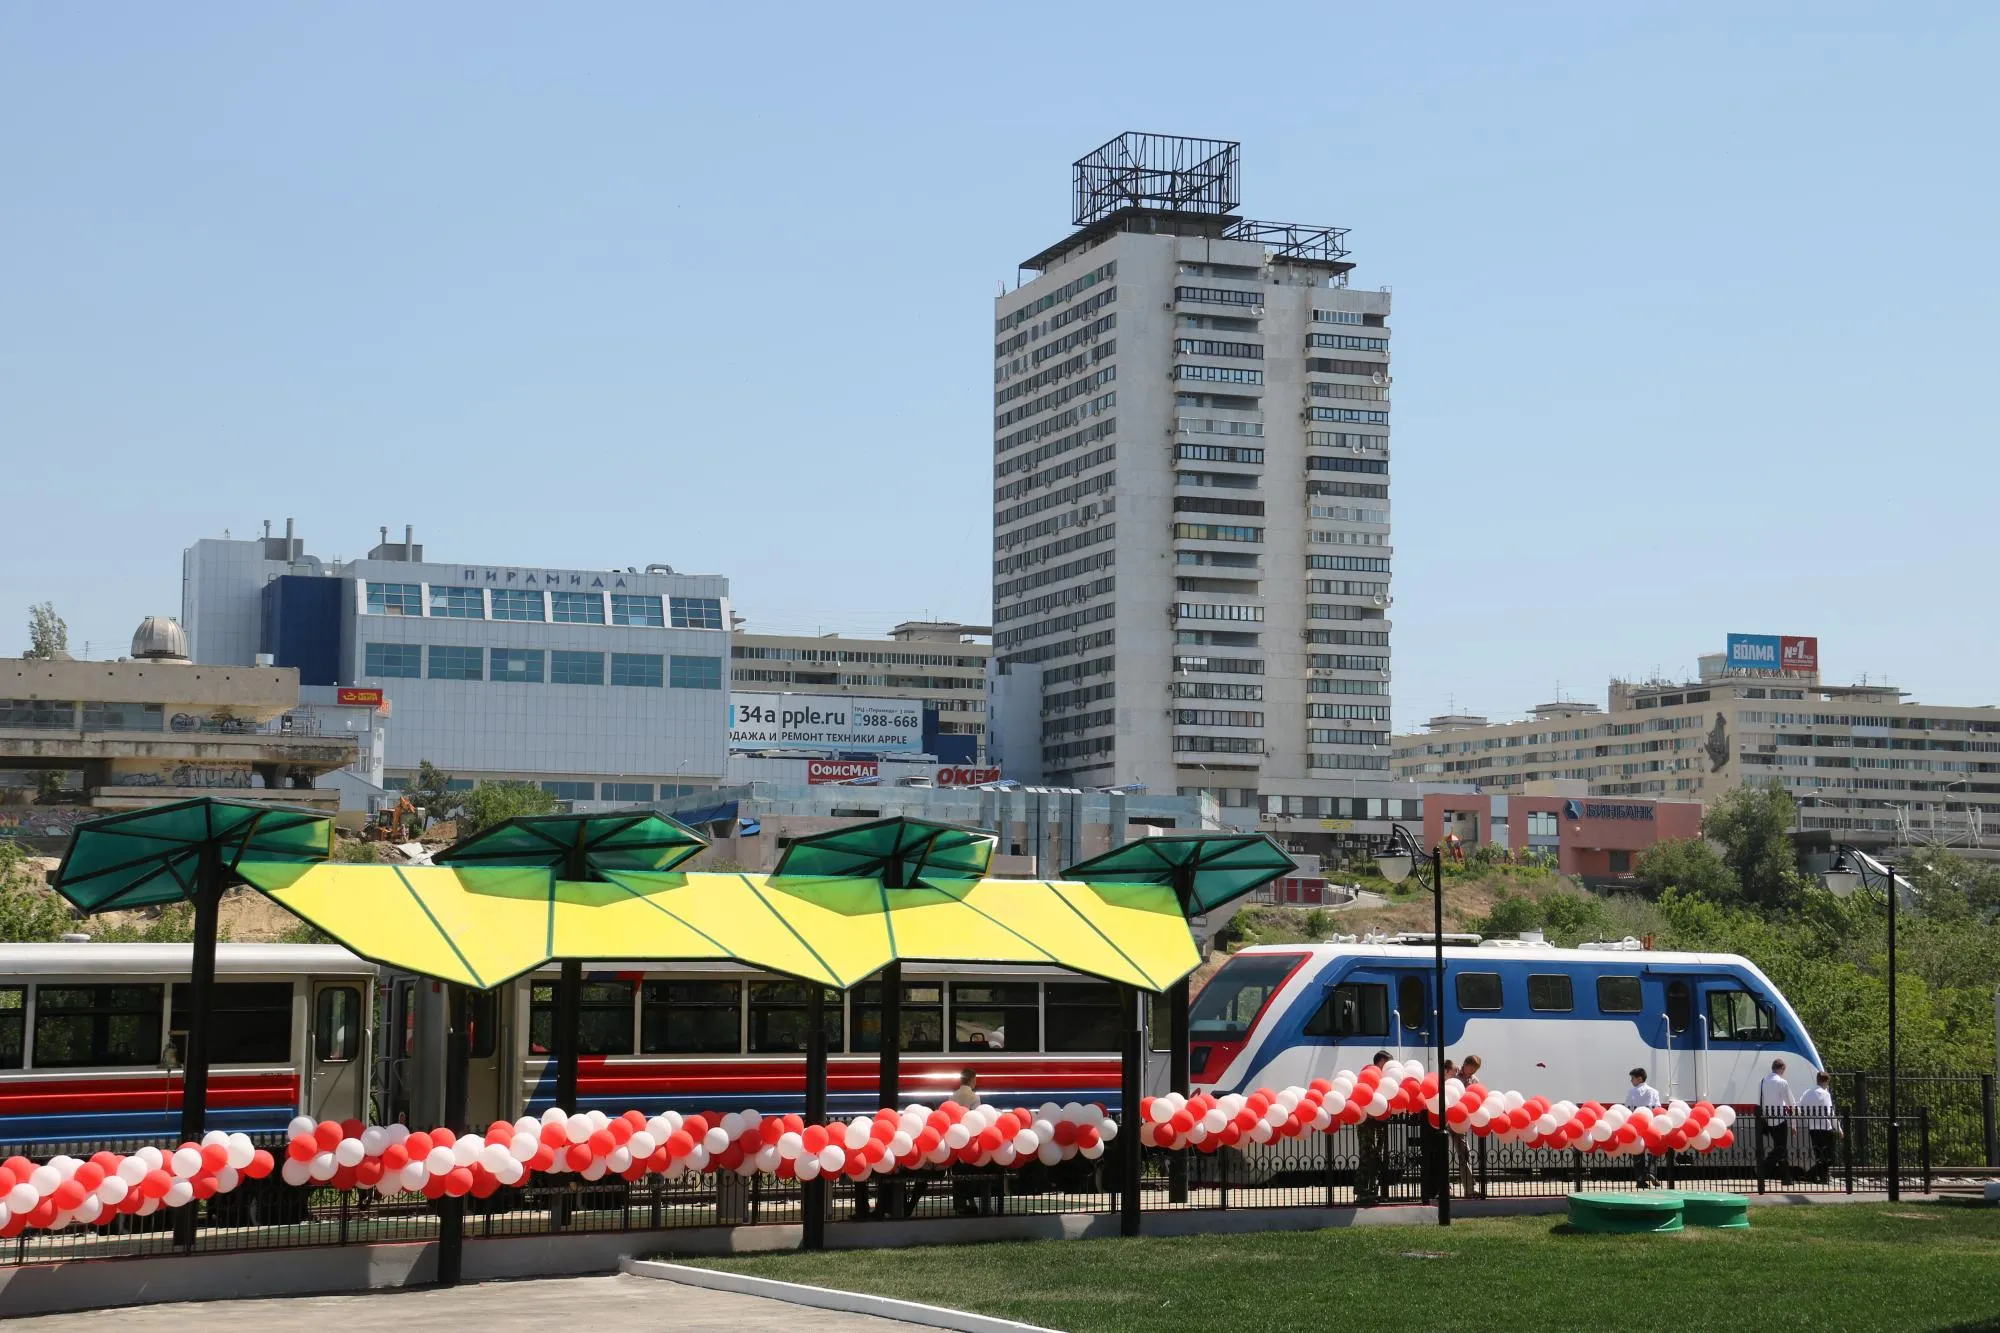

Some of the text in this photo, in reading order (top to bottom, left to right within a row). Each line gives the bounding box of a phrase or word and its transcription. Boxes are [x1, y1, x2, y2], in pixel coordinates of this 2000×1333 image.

[464, 569, 626, 588] ПИРАМИДА
[1733, 641, 1774, 661] ВОЛМА
[863, 714, 918, 728] 988-668
[769, 732, 777, 741] И
[781, 732, 824, 742] РЕМОНТ
[826, 733, 875, 743] ТЕХНИКИ
[877, 735, 907, 744] APPLE
[1587, 804, 1654, 819] БИНБАНК
